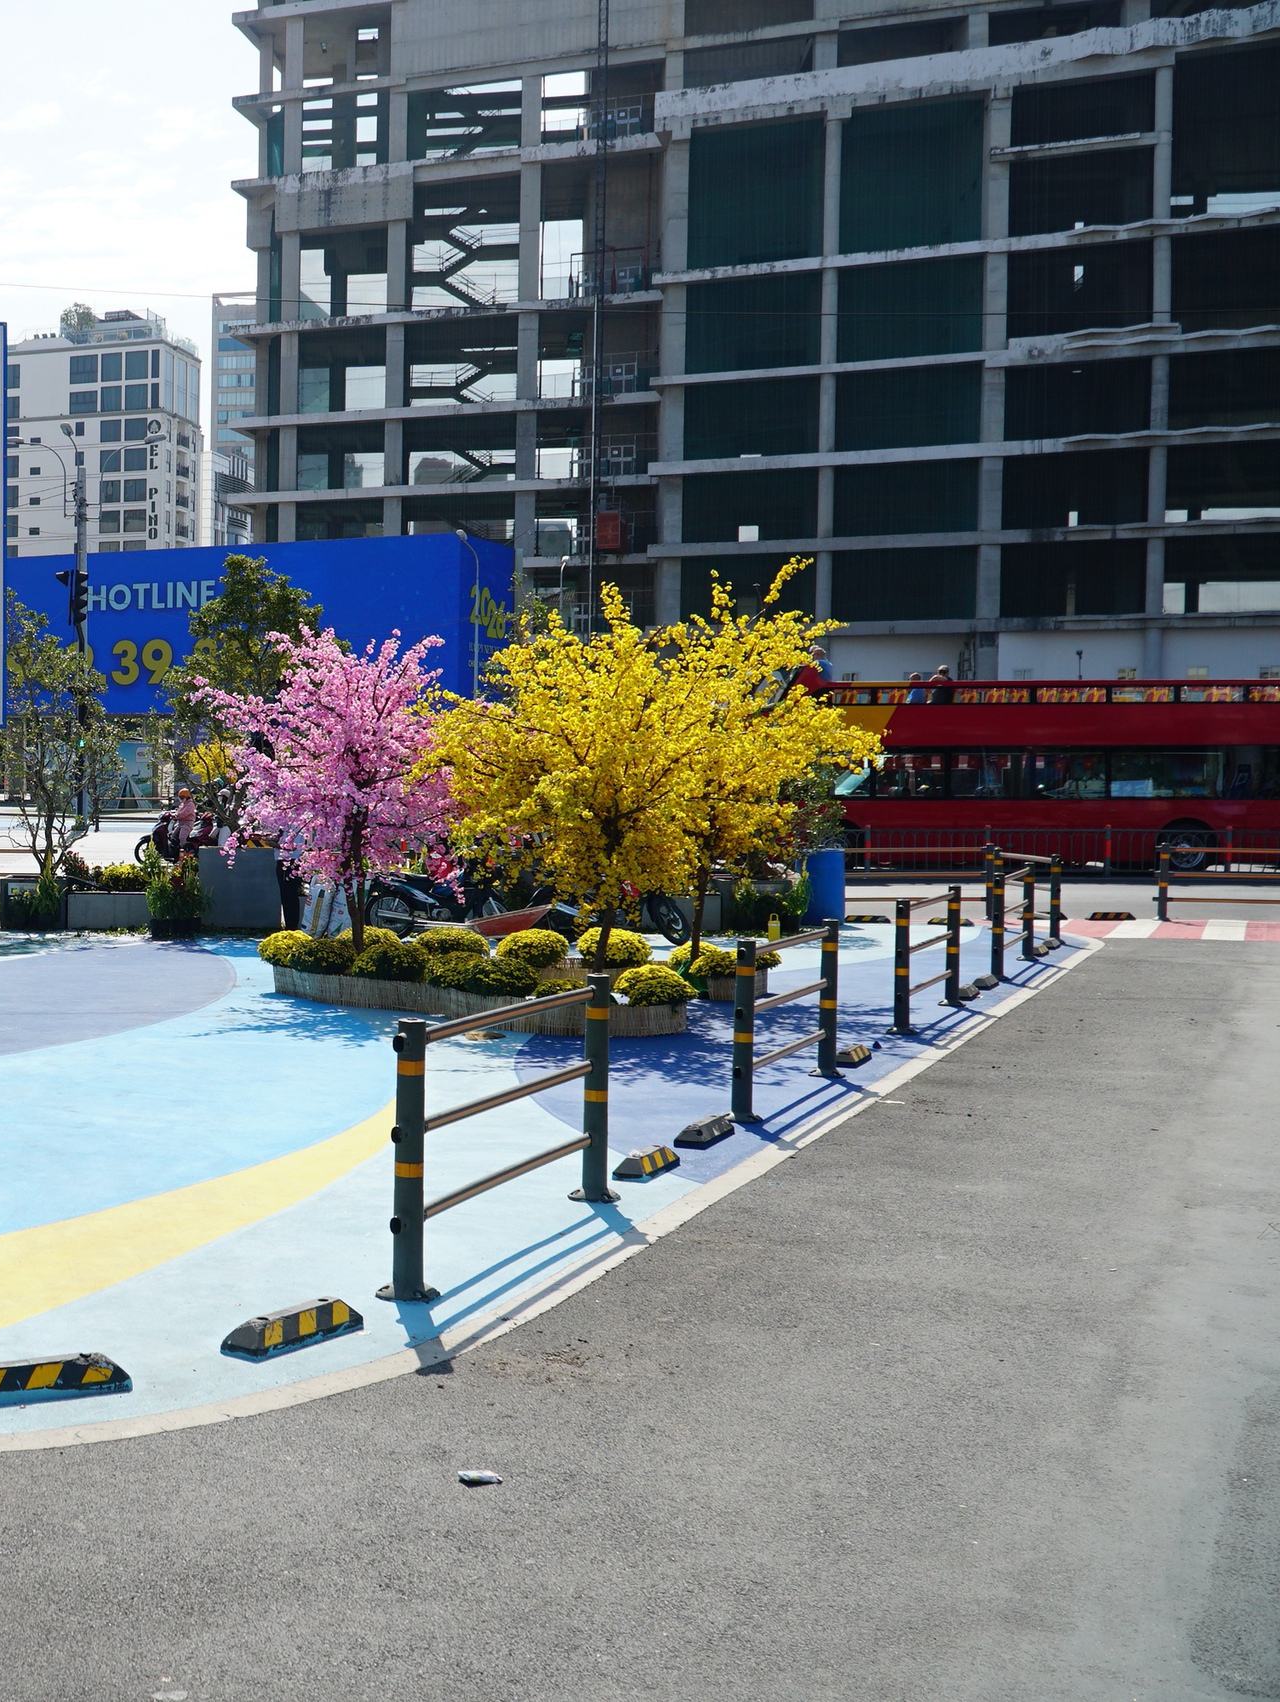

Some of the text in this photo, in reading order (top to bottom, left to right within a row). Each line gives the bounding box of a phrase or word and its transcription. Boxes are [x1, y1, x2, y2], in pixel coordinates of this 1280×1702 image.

[148, 487, 158, 540] PINO
[87, 580, 216, 612] HOTLINE
[470, 584, 506, 639] 2026
